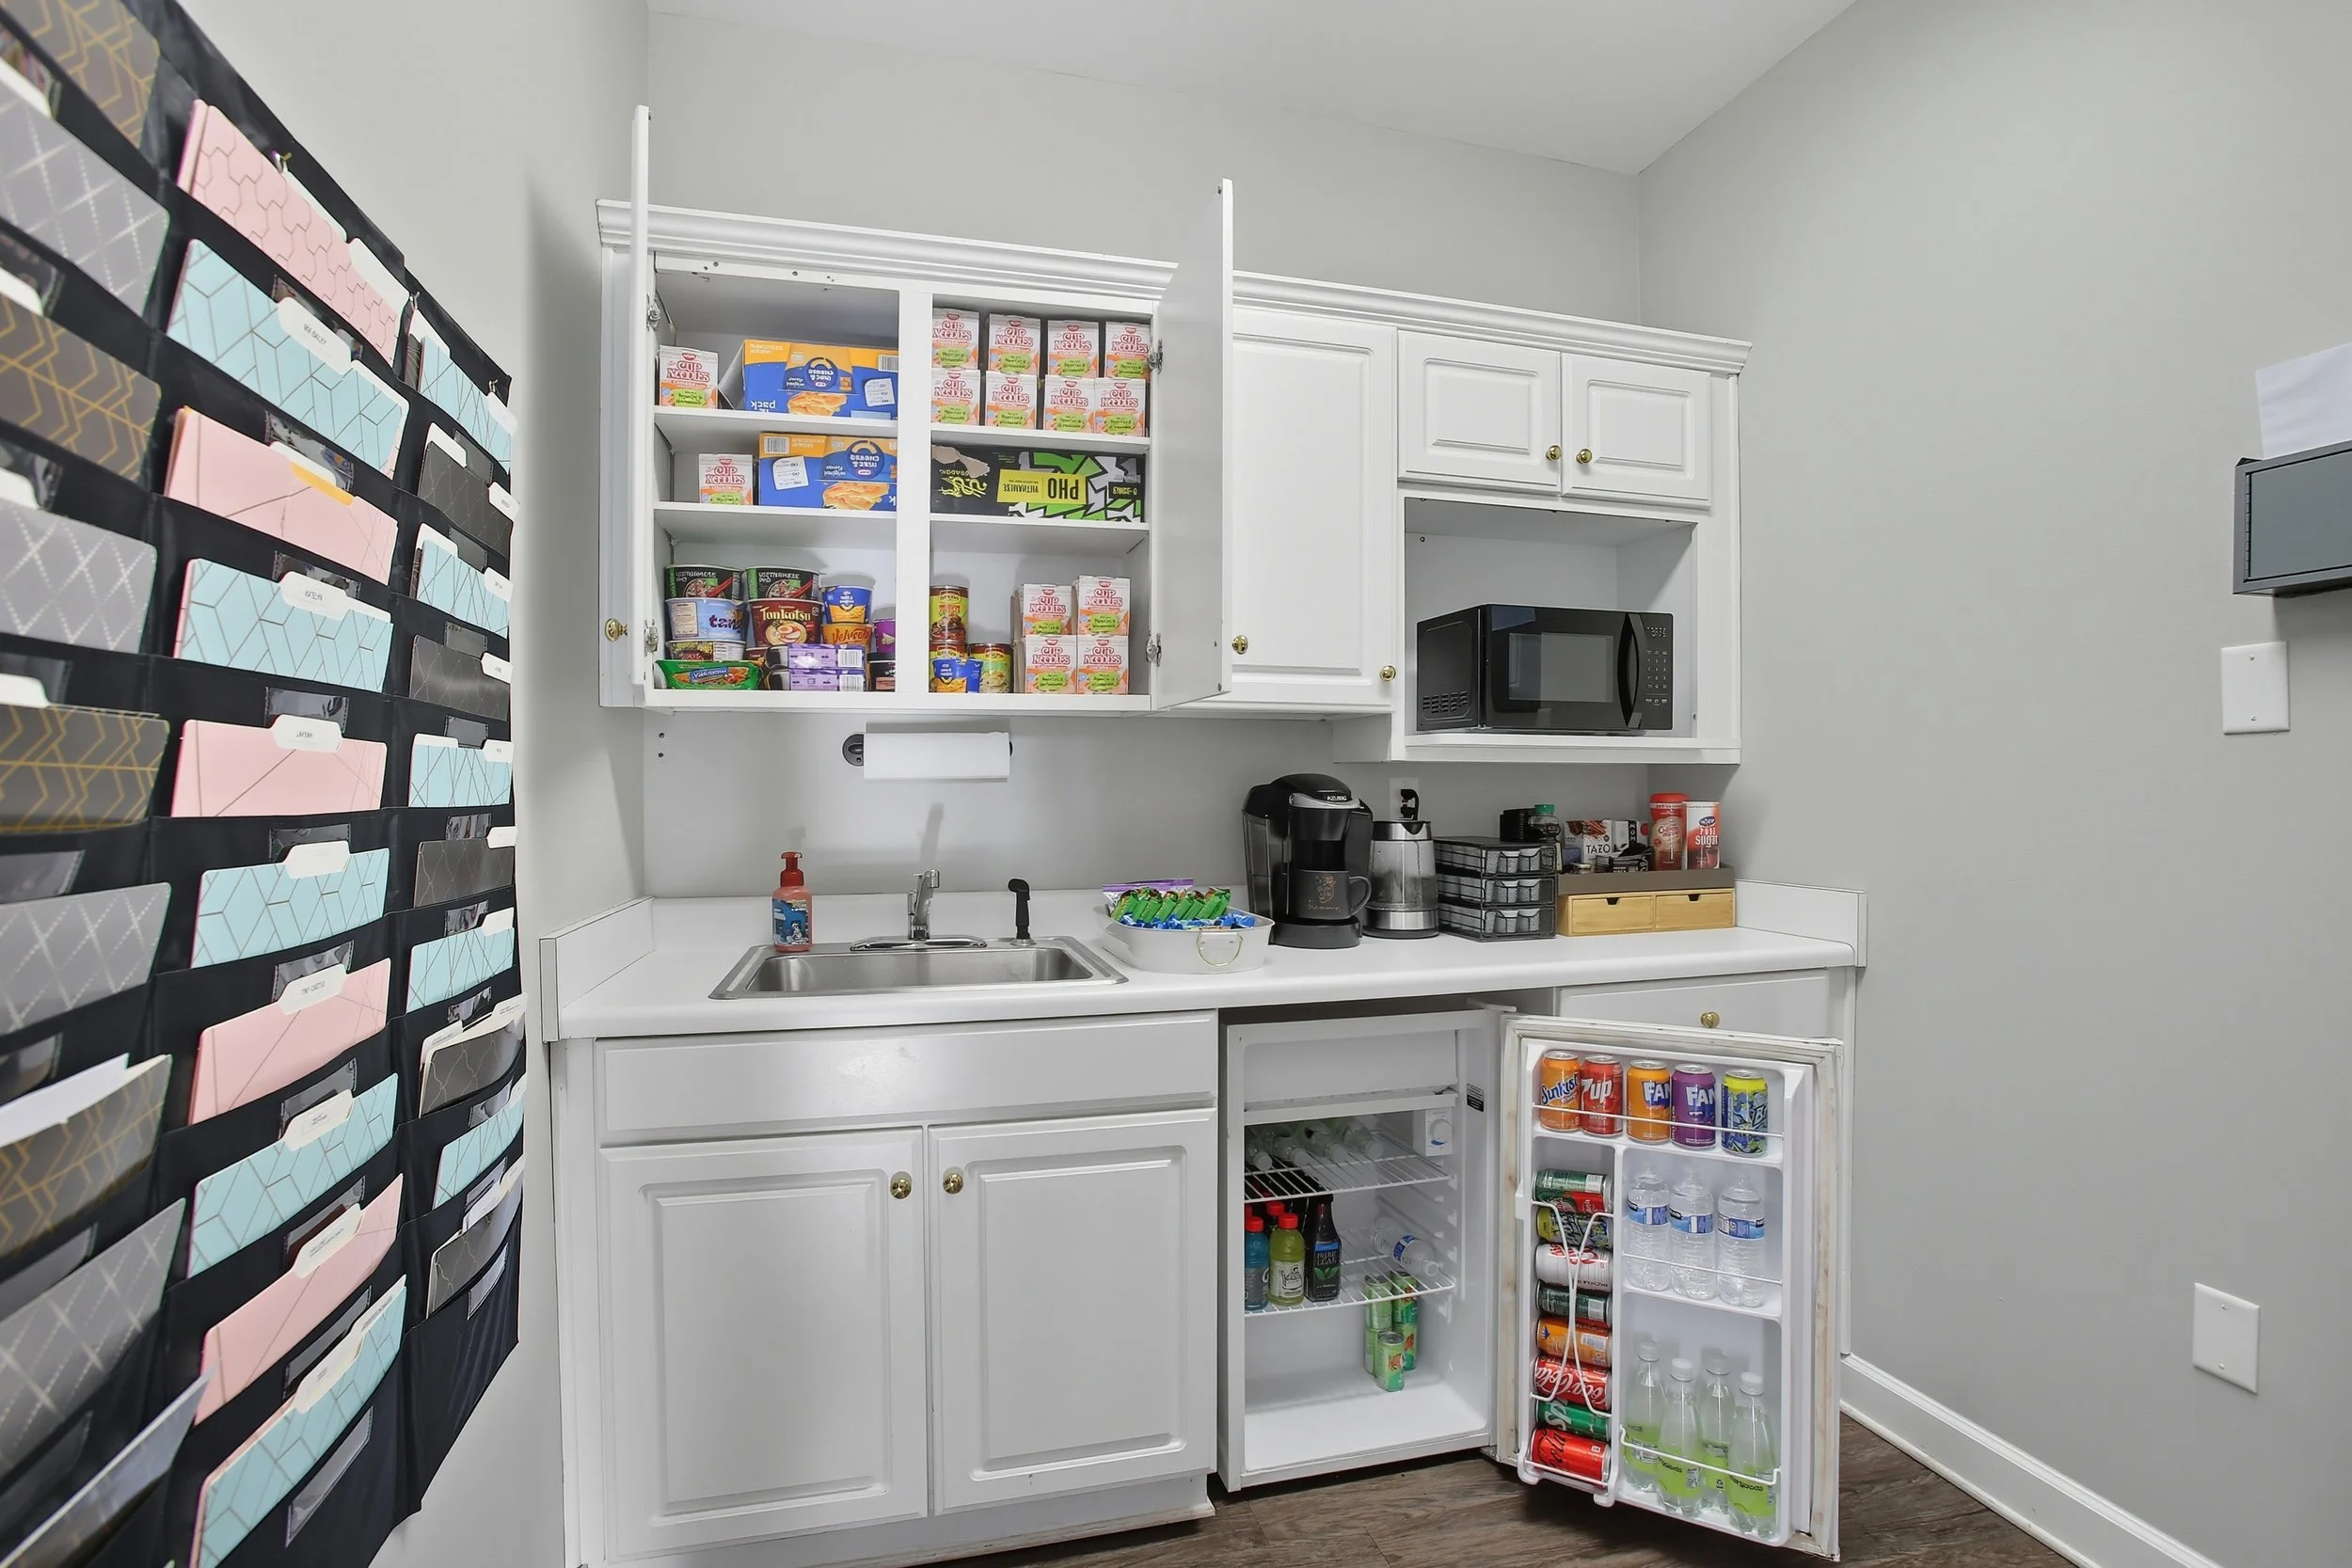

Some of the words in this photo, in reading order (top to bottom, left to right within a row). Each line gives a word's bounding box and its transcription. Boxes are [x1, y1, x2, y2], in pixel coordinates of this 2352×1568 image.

[942, 321, 964, 330] CUP
[931, 328, 972, 341] NOODLES
[1005, 327, 1026, 337] CUP
[1063, 333, 1085, 341] CUP
[995, 335, 1033, 346] NOODLES
[1120, 334, 1141, 343] CUP
[1054, 341, 1091, 351] NOODLES
[1112, 341, 1149, 354] NOODLES
[677, 361, 702, 372] CUP
[667, 368, 710, 382] NOODLES
[944, 379, 966, 388] CUP
[934, 388, 973, 399] NOODLES
[1001, 385, 1023, 394] CUP
[1060, 388, 1081, 397] CUP
[1109, 390, 1131, 399] CUP
[993, 391, 1030, 403] NOODLES
[1051, 395, 1089, 406] NOODLES
[751, 400, 776, 410] pack
[1101, 398, 1138, 407] NOODLES
[714, 467, 738, 476] CUP
[706, 474, 745, 484] NOODLES
[1048, 478, 1078, 500] PHO
[1094, 589, 1116, 597] CUP
[1038, 596, 1059, 605] CUP
[1085, 596, 1122, 607] NOODLES
[1029, 603, 1066, 614] NOODLES
[760, 607, 811, 622] Tonkotsu
[1041, 647, 1063, 656] CUP
[1092, 647, 1114, 656] CUP
[1032, 655, 1071, 665] NOODLES
[1084, 655, 1121, 665] NOODLES
[1586, 844, 1611, 854] TAZO
[1541, 1072, 1579, 1105] Sunkist
[1535, 1367, 1607, 1409] Coca-Cola
